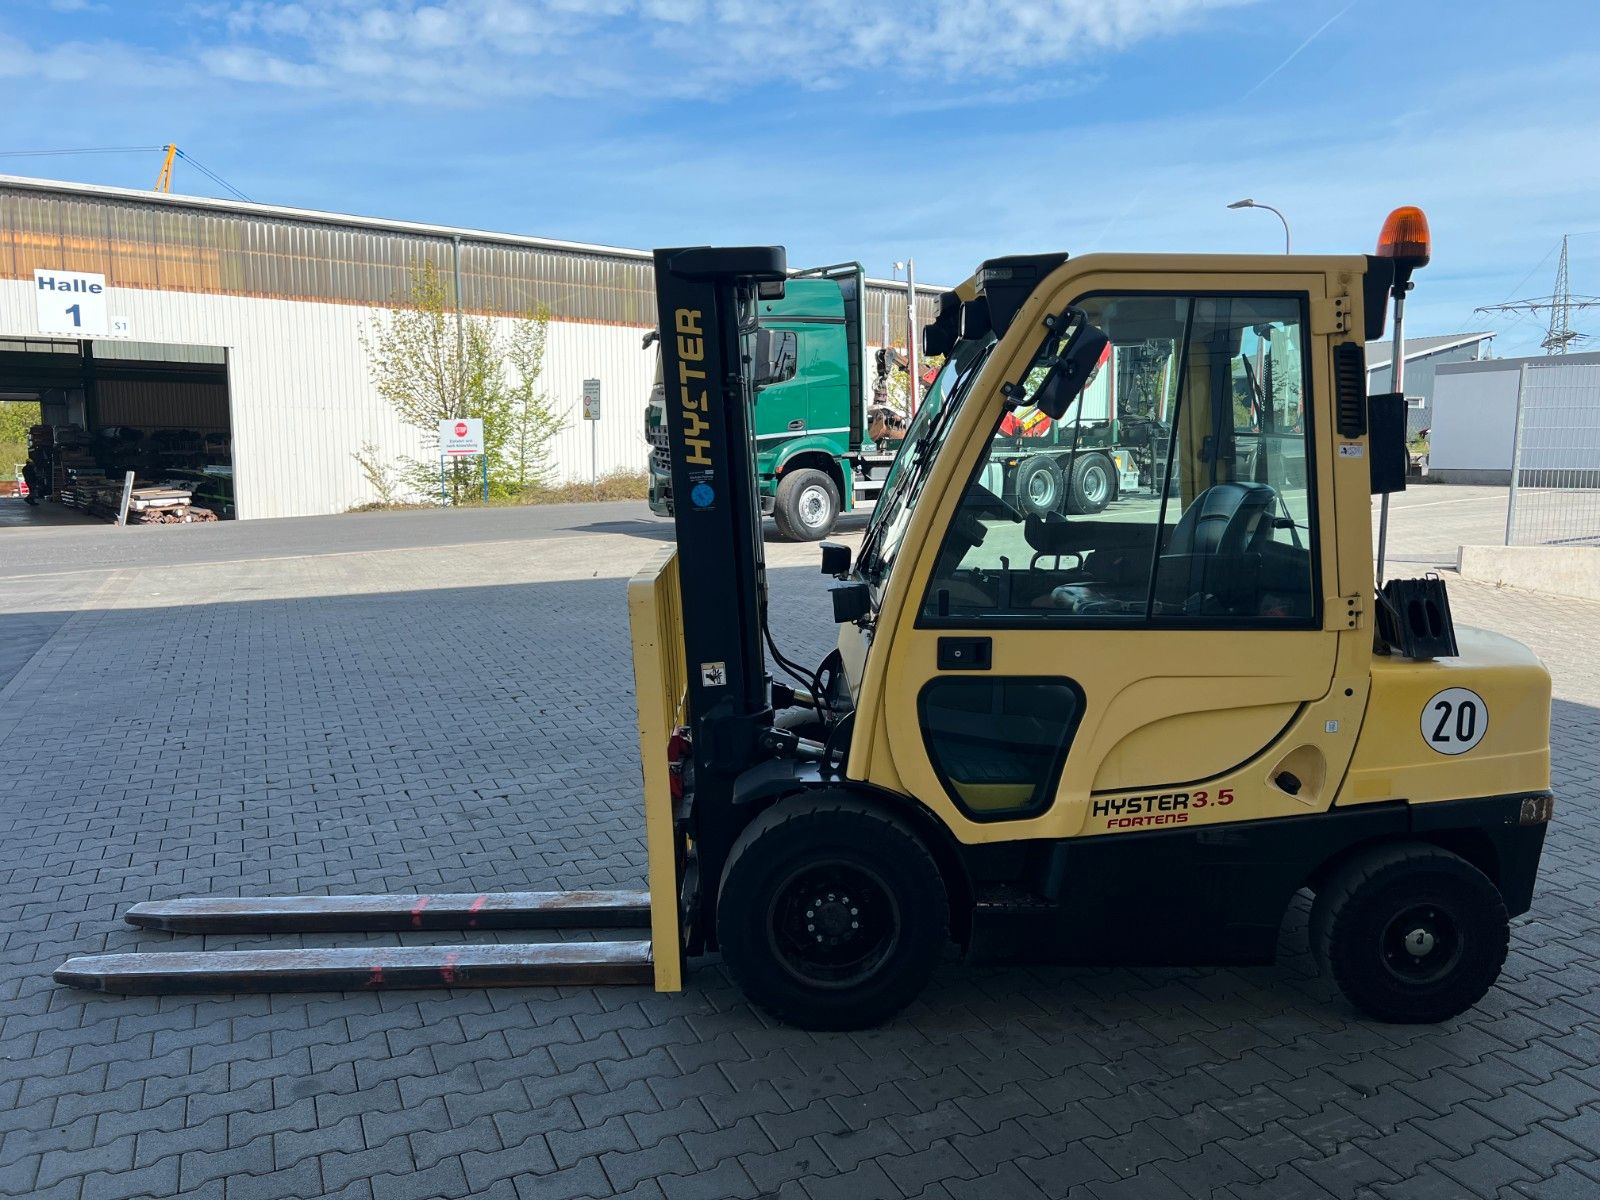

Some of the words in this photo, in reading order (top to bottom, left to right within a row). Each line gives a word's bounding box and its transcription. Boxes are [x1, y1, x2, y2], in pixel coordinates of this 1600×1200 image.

[38, 276, 103, 294] Halle
[65, 304, 81, 327] 1
[675, 308, 712, 465] HYSTER
[1432, 700, 1476, 743] 20
[1092, 793, 1190, 817] HYSTER
[1192, 788, 1235, 809] 3.5
[1107, 812, 1189, 829] FORTENS
